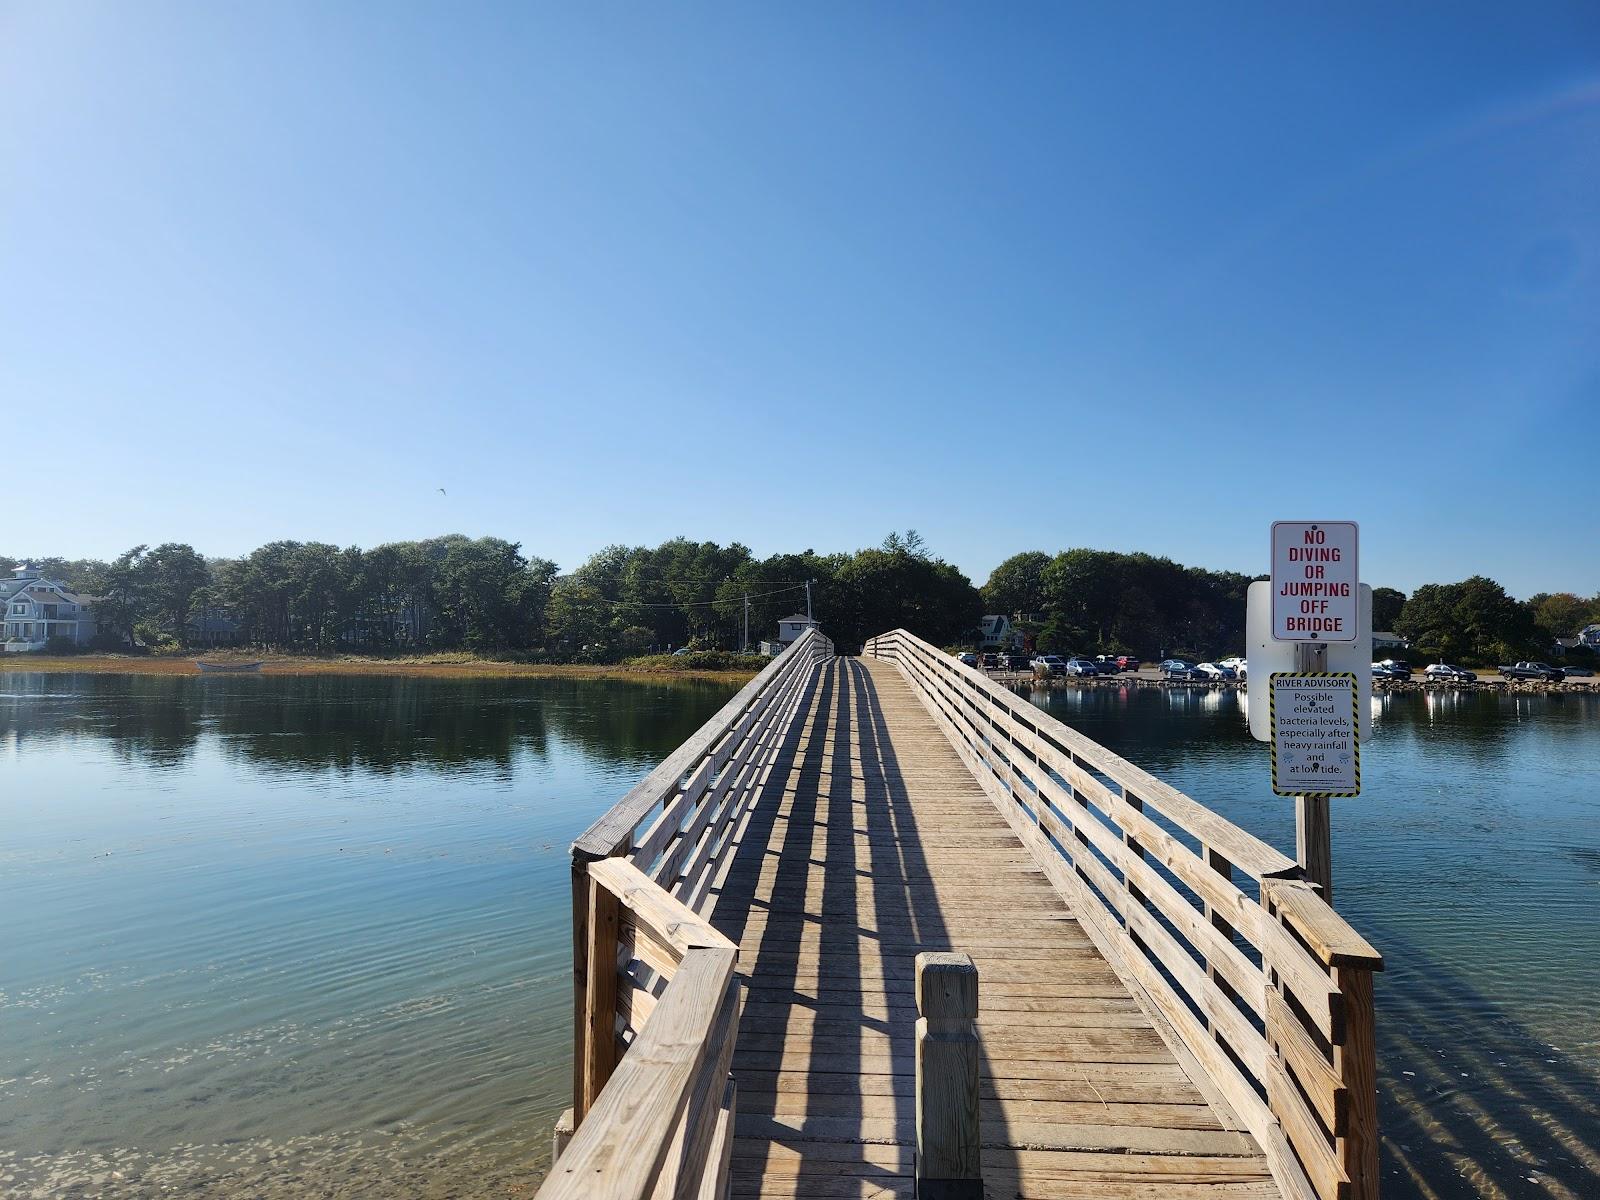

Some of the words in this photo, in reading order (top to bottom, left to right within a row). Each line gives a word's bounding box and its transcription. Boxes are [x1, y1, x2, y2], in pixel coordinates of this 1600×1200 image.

[1305, 531, 1325, 544] NO
[1290, 548, 1341, 561] DIVING
[1305, 565, 1324, 578] OR
[1280, 583, 1349, 596] JUMPING
[1301, 600, 1328, 614] OFF
[1287, 617, 1342, 631] BRIDGE
[1295, 693, 1333, 701] Possible
[1294, 705, 1334, 713] elevated
[1320, 718, 1350, 727] levels,
[1280, 729, 1325, 738] especially
[1328, 729, 1350, 738] after
[1284, 741, 1312, 751] heavy
[1315, 741, 1347, 750] rainfall
[1306, 753, 1325, 762] and
[1321, 766, 1342, 774] tide.
